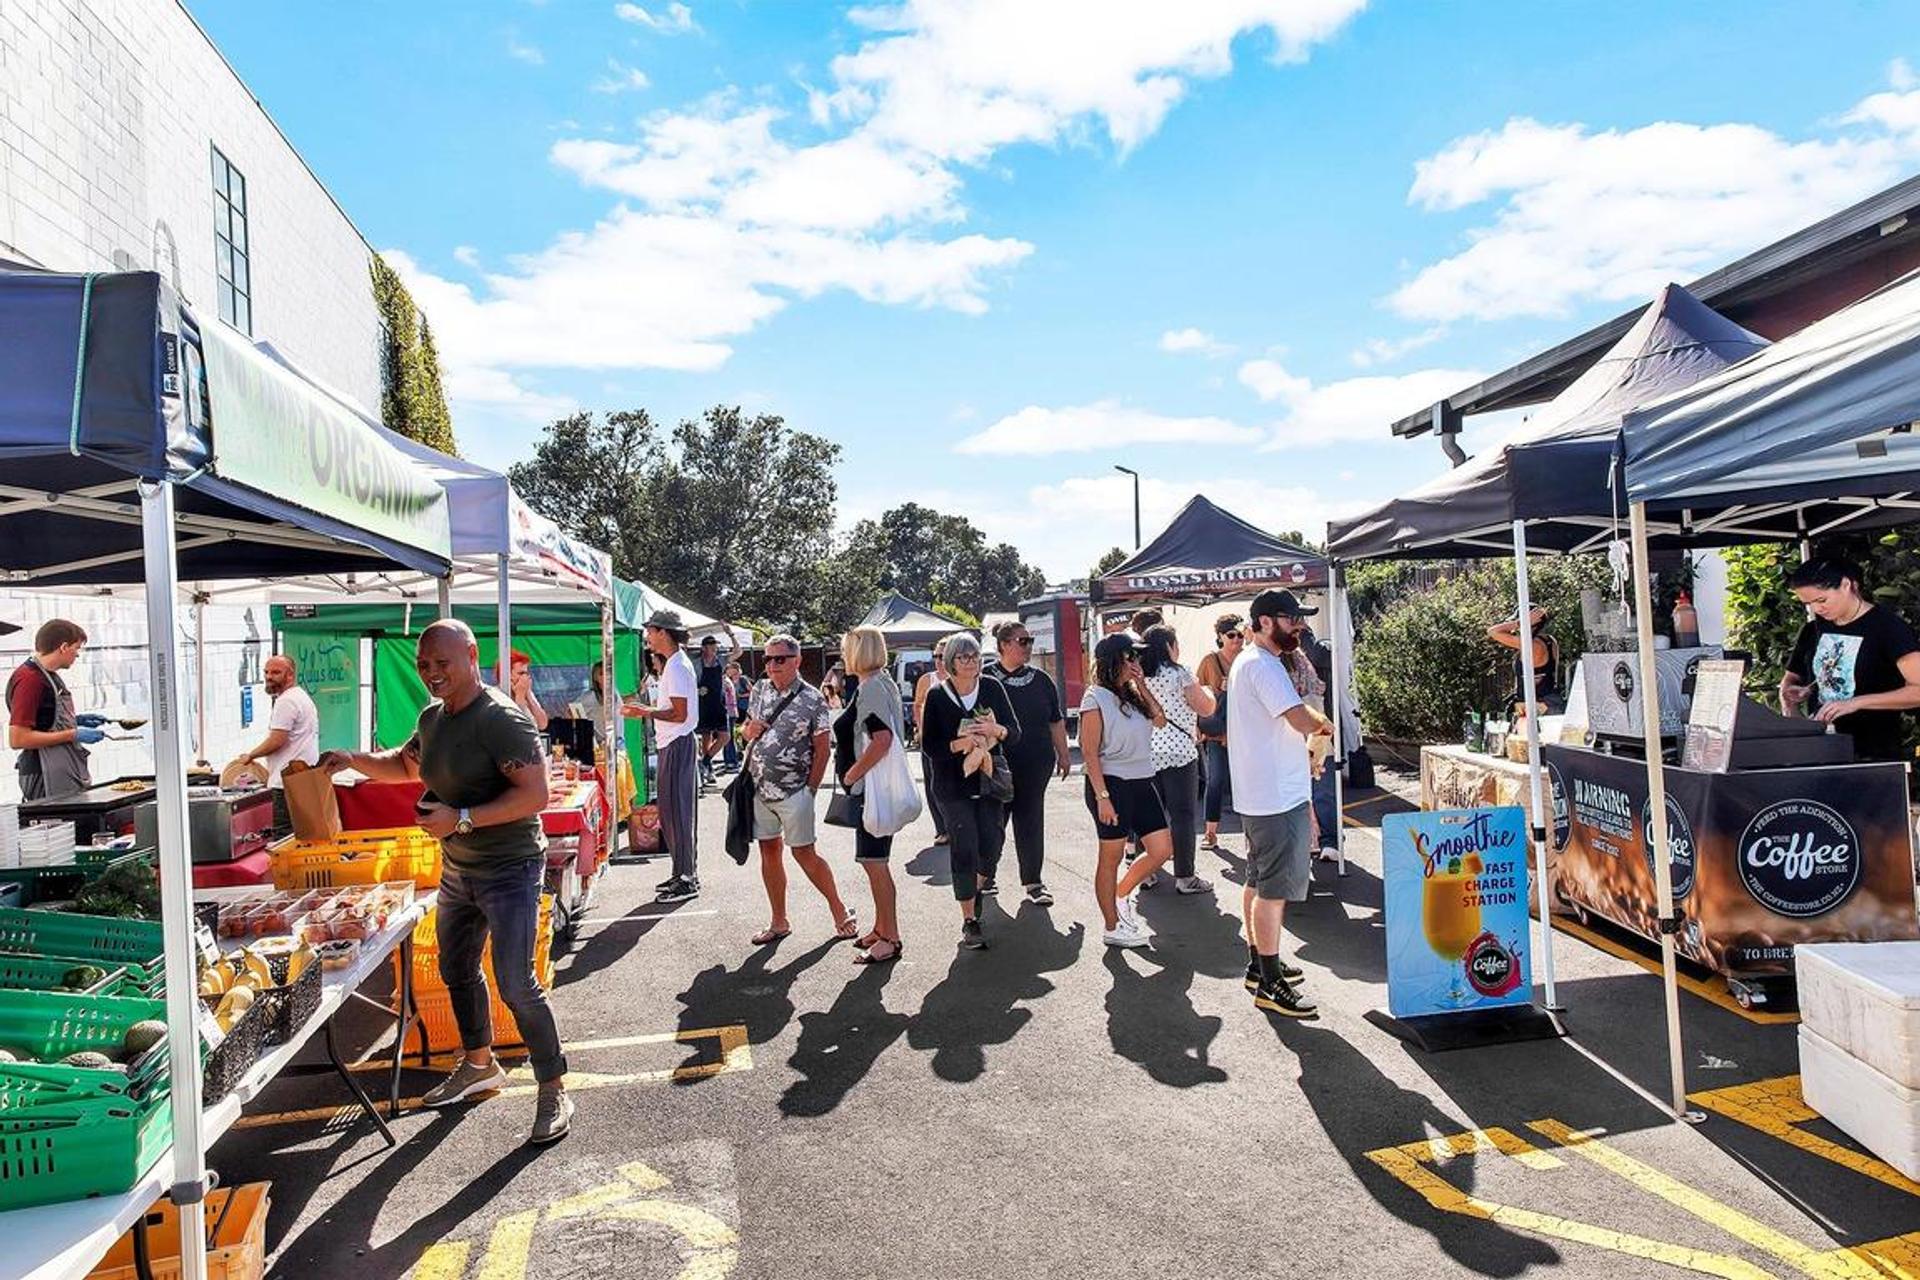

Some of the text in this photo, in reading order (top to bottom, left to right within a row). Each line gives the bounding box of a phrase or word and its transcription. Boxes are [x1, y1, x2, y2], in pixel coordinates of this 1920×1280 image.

[1574, 779, 1631, 817] WARNING
[1757, 805, 1847, 836] FEED THE ADDICTION
[1416, 813, 1516, 878] Smoothie
[1772, 835, 1790, 843] THE
[1747, 832, 1850, 880] Coffee
[1486, 861, 1515, 875] FAST
[1815, 865, 1848, 875] STORE
[1465, 877, 1516, 892] CHARGE
[1463, 892, 1516, 908] STATION
[1473, 955, 1508, 975] Coffee
